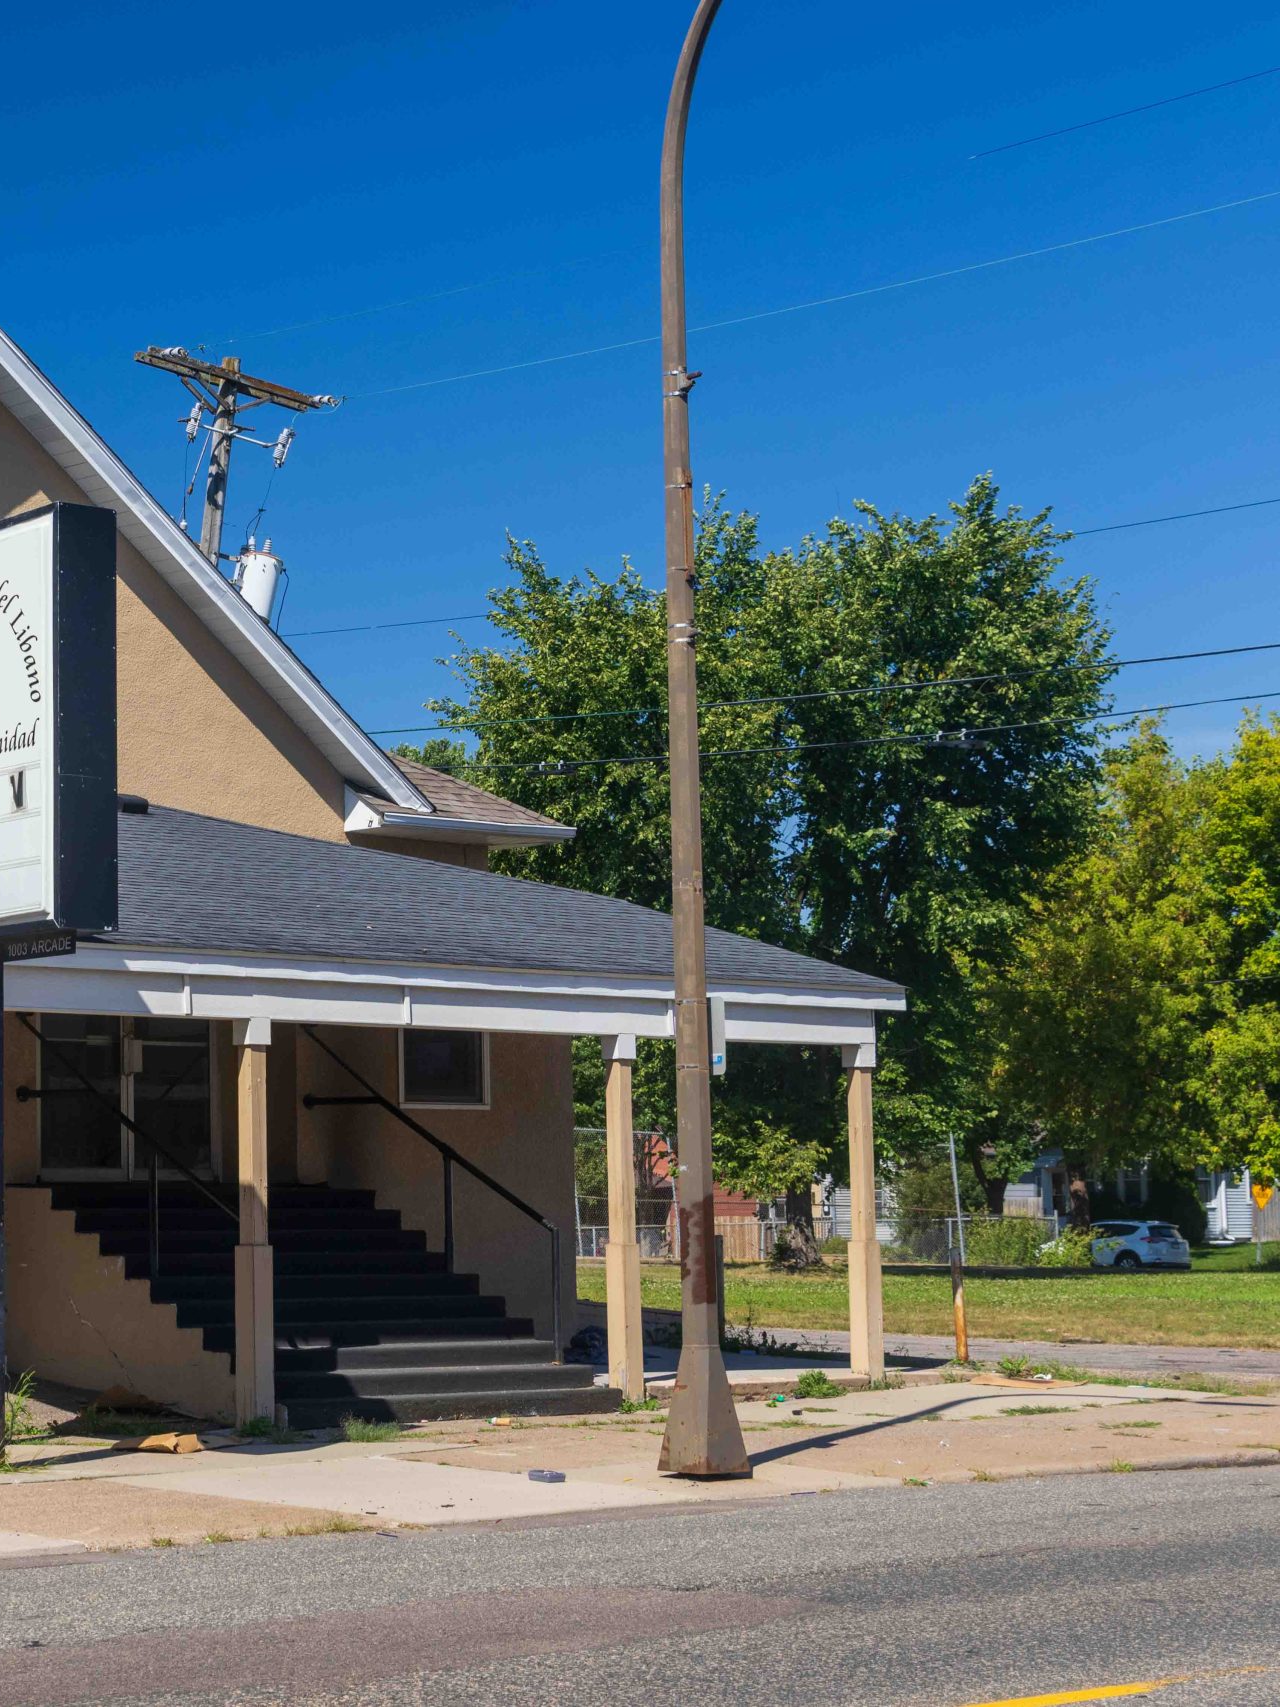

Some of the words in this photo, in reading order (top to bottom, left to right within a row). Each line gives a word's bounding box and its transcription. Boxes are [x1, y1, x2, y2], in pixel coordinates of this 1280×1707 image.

[9, 608, 42, 703] Libano
[9, 770, 24, 809] V
[8, 942, 28, 957] 1003
[31, 936, 72, 954] ARCADE
